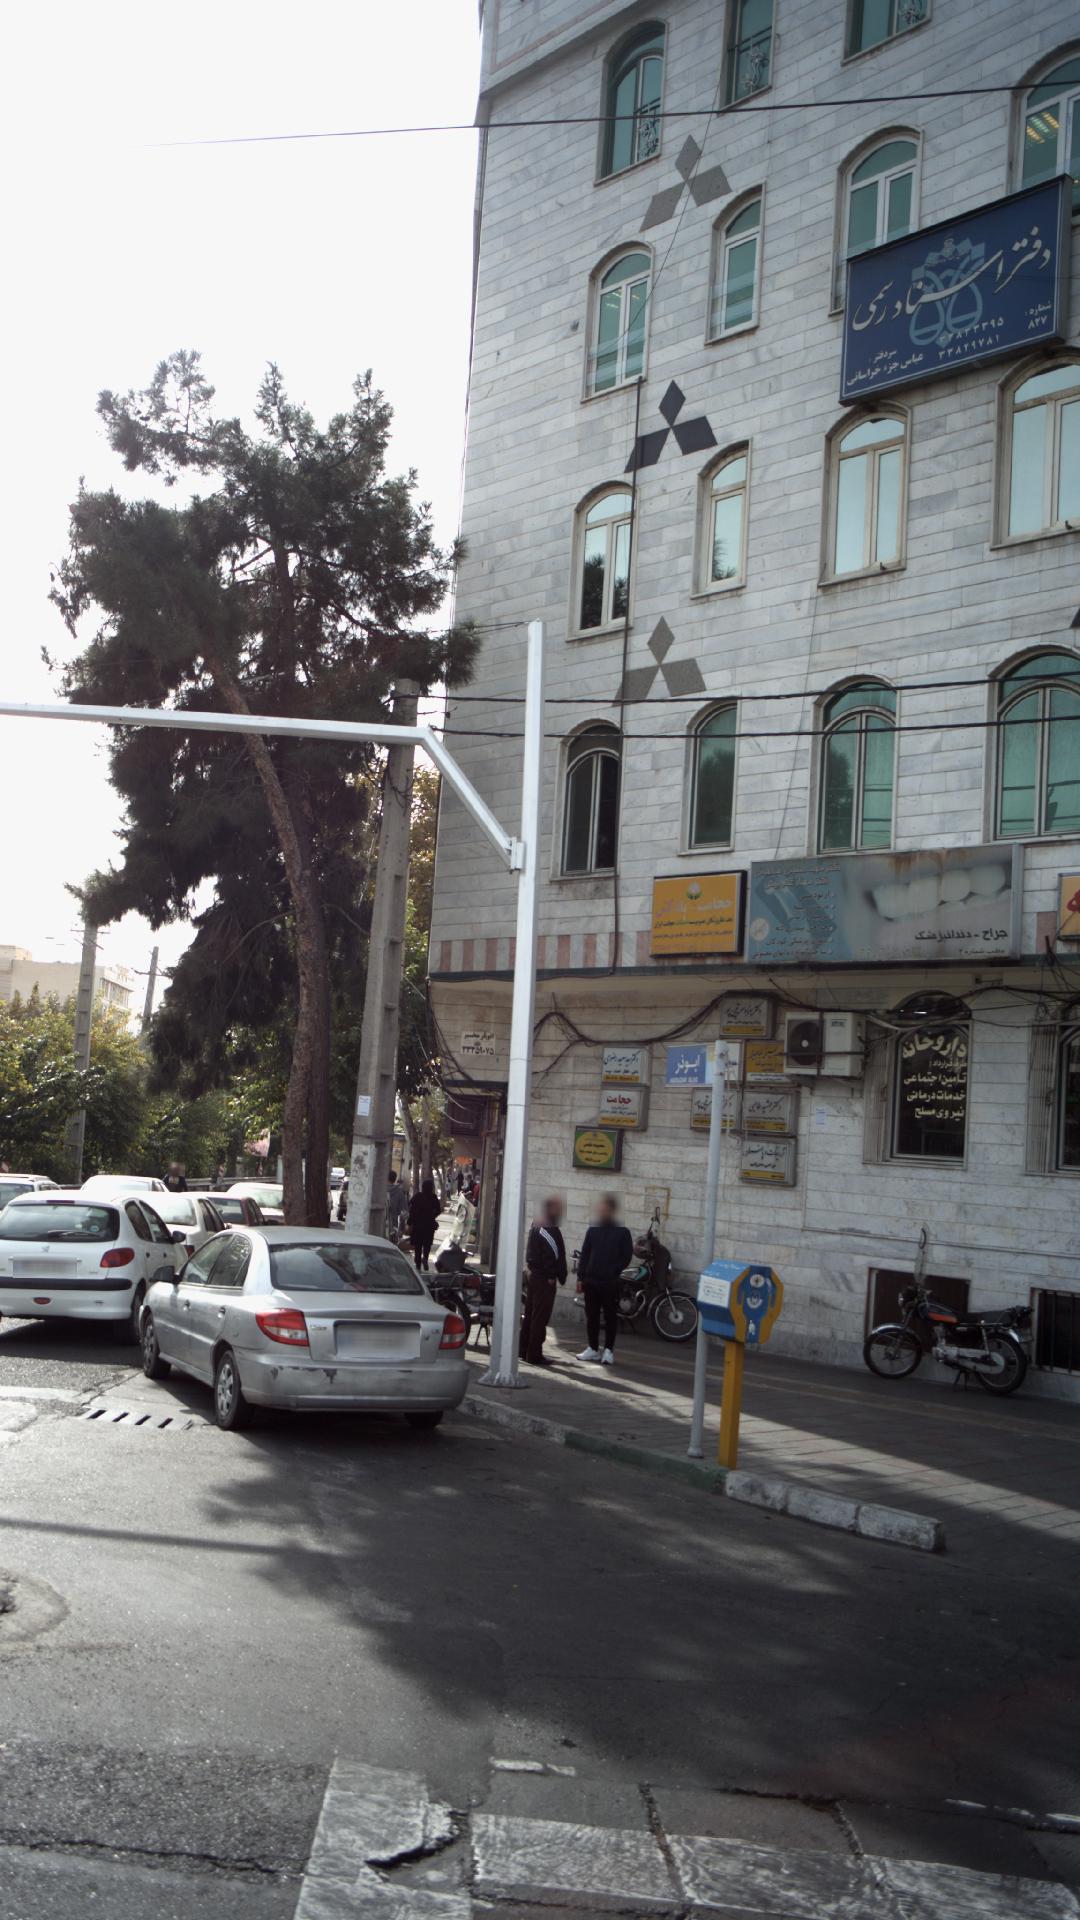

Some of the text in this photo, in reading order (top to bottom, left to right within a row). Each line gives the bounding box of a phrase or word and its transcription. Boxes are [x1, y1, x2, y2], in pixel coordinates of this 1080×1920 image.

[852, 226, 1051, 331] دفتر اسناد رسمی
[900, 353, 924, 370] عباس
[847, 364, 881, 386] خراسانی
[981, 927, 1008, 941] جراح
[902, 1031, 967, 1059] داروخانه
[674, 1053, 701, 1075] ابوذر
[904, 1071, 941, 1087] اجتماعی
[606, 1094, 632, 1106] حجامت
[906, 1089, 966, 1103] خدمات درمانی
[914, 1106, 936, 1119] مسلح
